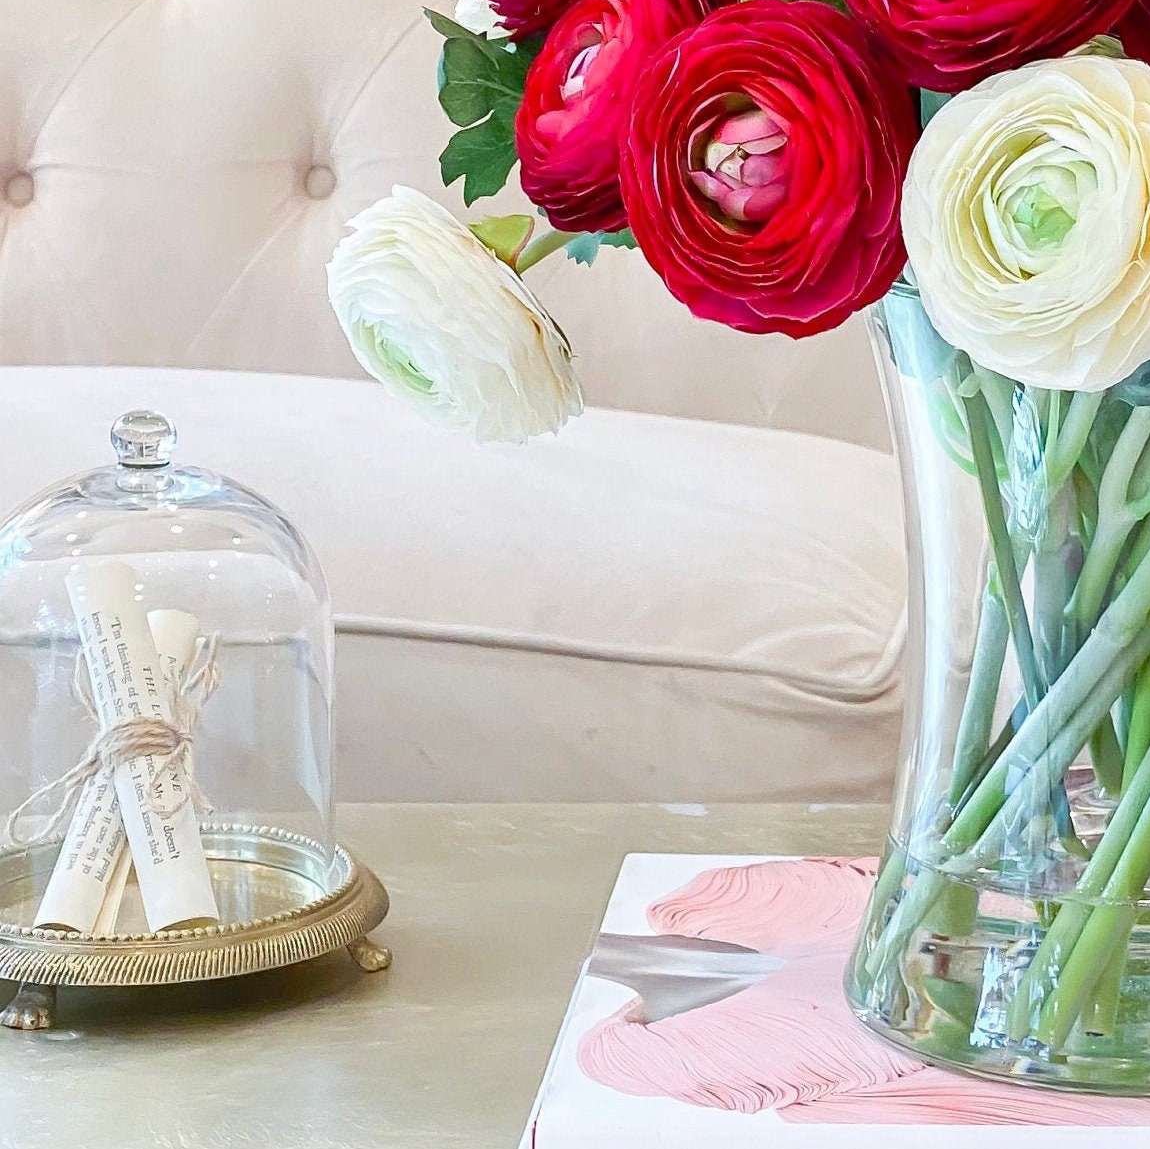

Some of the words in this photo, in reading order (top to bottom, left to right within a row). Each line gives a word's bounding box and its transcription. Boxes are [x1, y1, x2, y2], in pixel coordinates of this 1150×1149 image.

[91, 612, 105, 636] know
[100, 646, 114, 670] work
[114, 643, 135, 684] thinking
[127, 686, 139, 698] of
[148, 839, 163, 865] she'd
[162, 824, 181, 860] doesn't
[93, 857, 113, 883] blind
